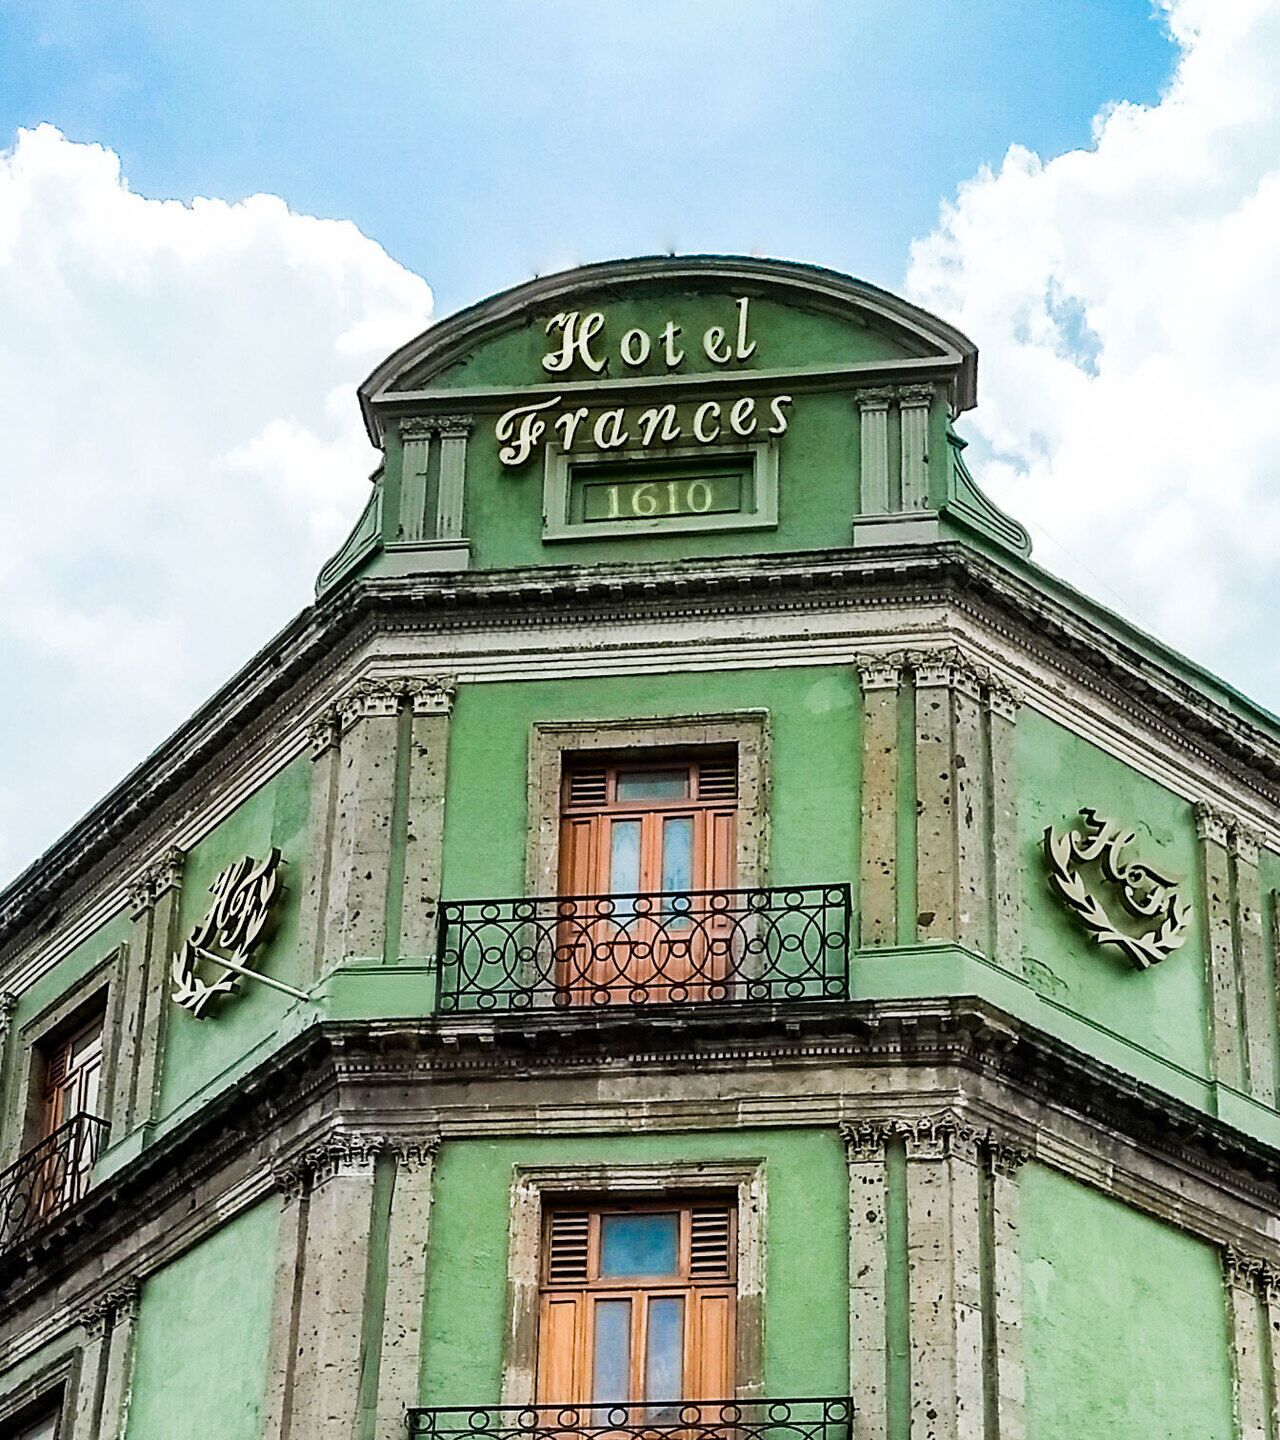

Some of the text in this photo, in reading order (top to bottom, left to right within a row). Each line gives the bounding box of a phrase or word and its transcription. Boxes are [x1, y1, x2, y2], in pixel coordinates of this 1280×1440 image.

[541, 297, 757, 373] Hotel
[495, 395, 792, 466] Frances
[606, 480, 713, 519] 1610
